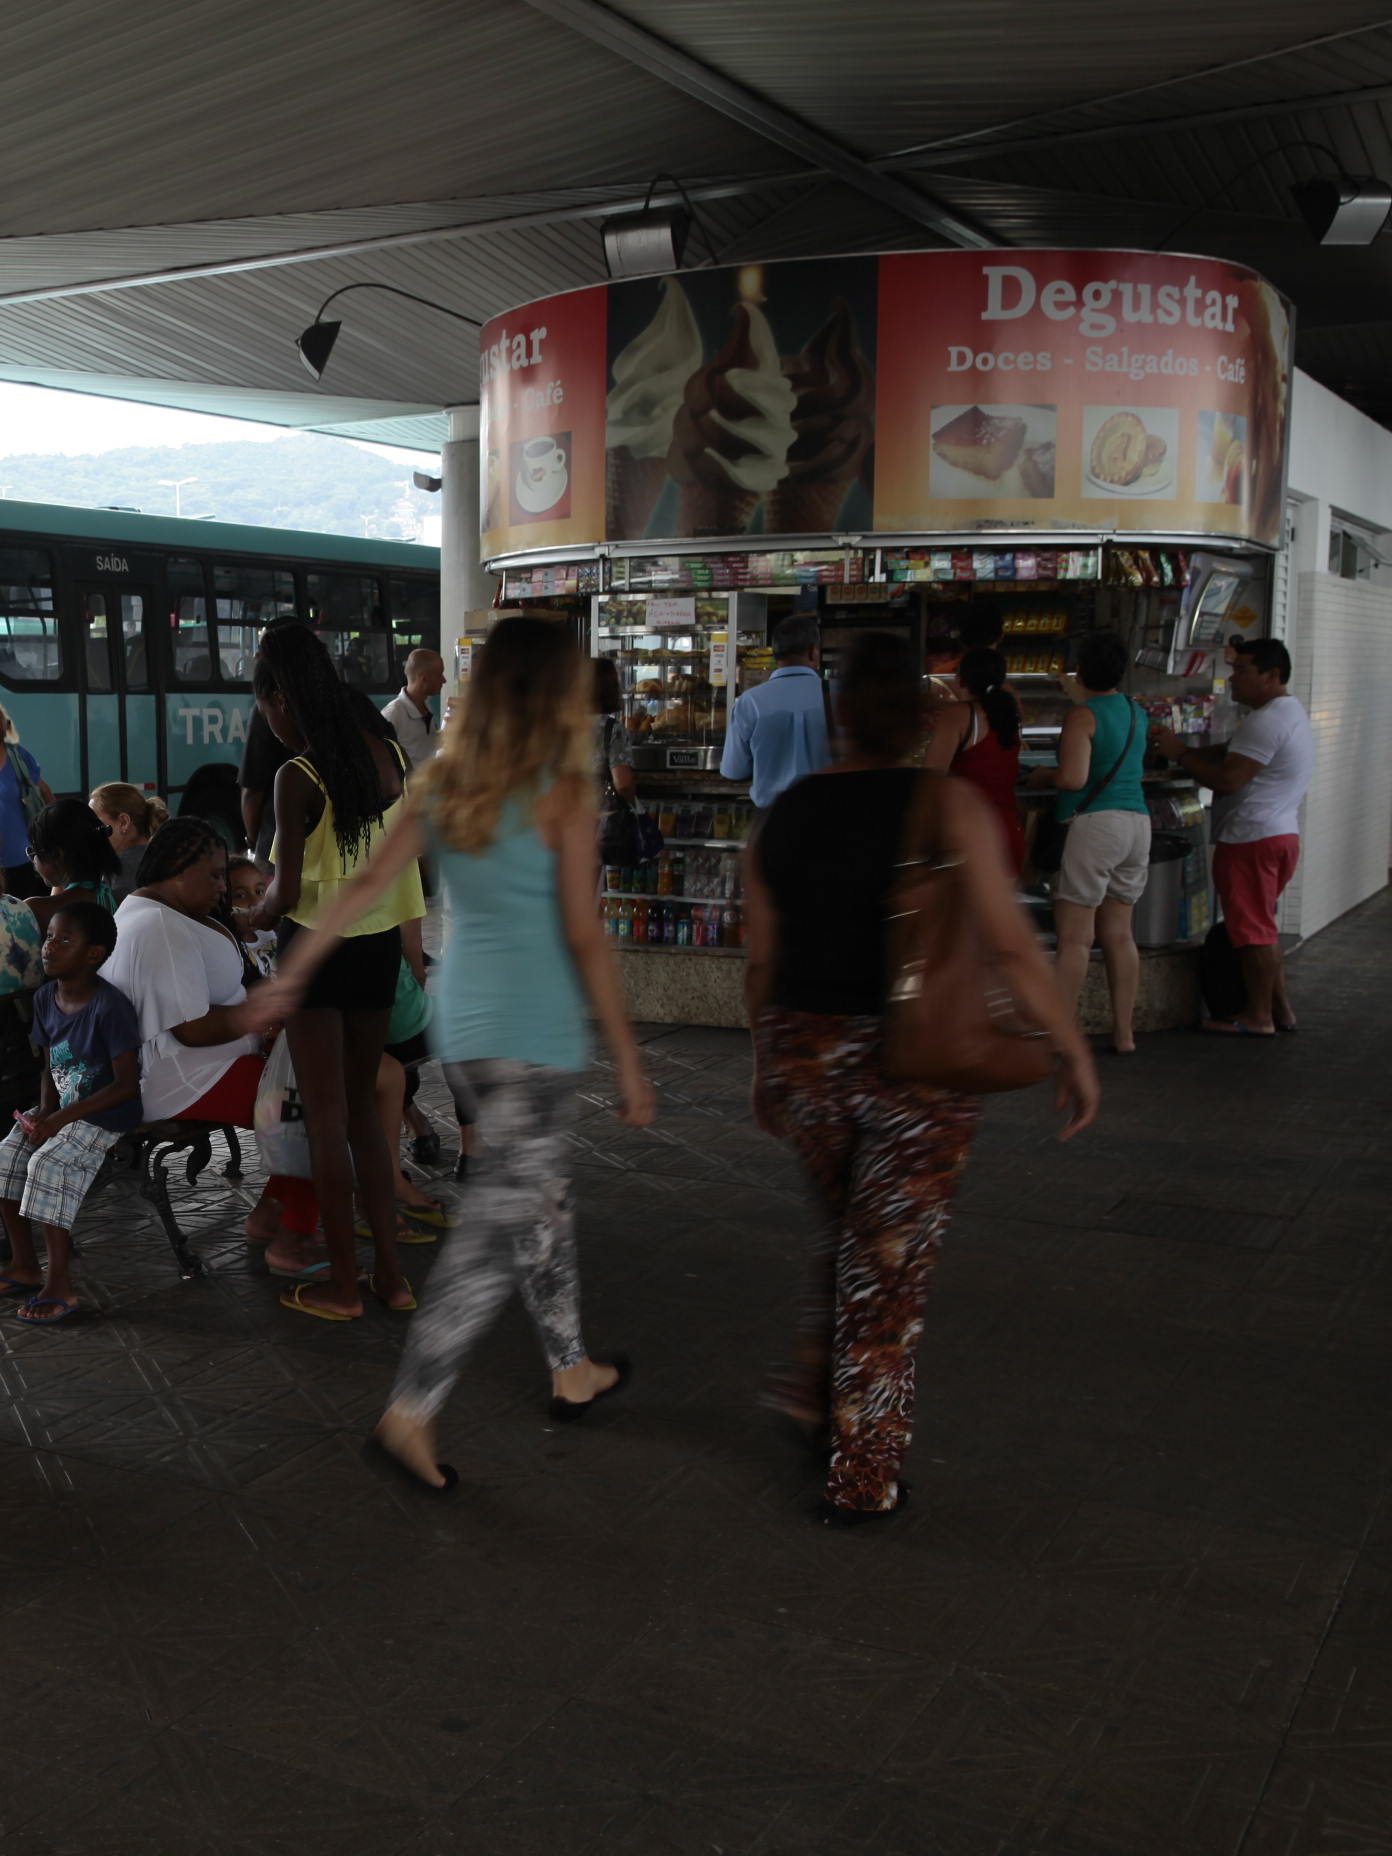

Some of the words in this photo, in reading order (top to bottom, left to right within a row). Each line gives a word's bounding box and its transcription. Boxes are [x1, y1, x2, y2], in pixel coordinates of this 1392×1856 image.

[980, 266, 1239, 338] Degustar
[947, 346, 1053, 372] Doces
[1084, 345, 1199, 381] Salgados
[1216, 354, 1246, 384] Café
[523, 379, 563, 410] Café
[95, 553, 129, 573] SAÍDA
